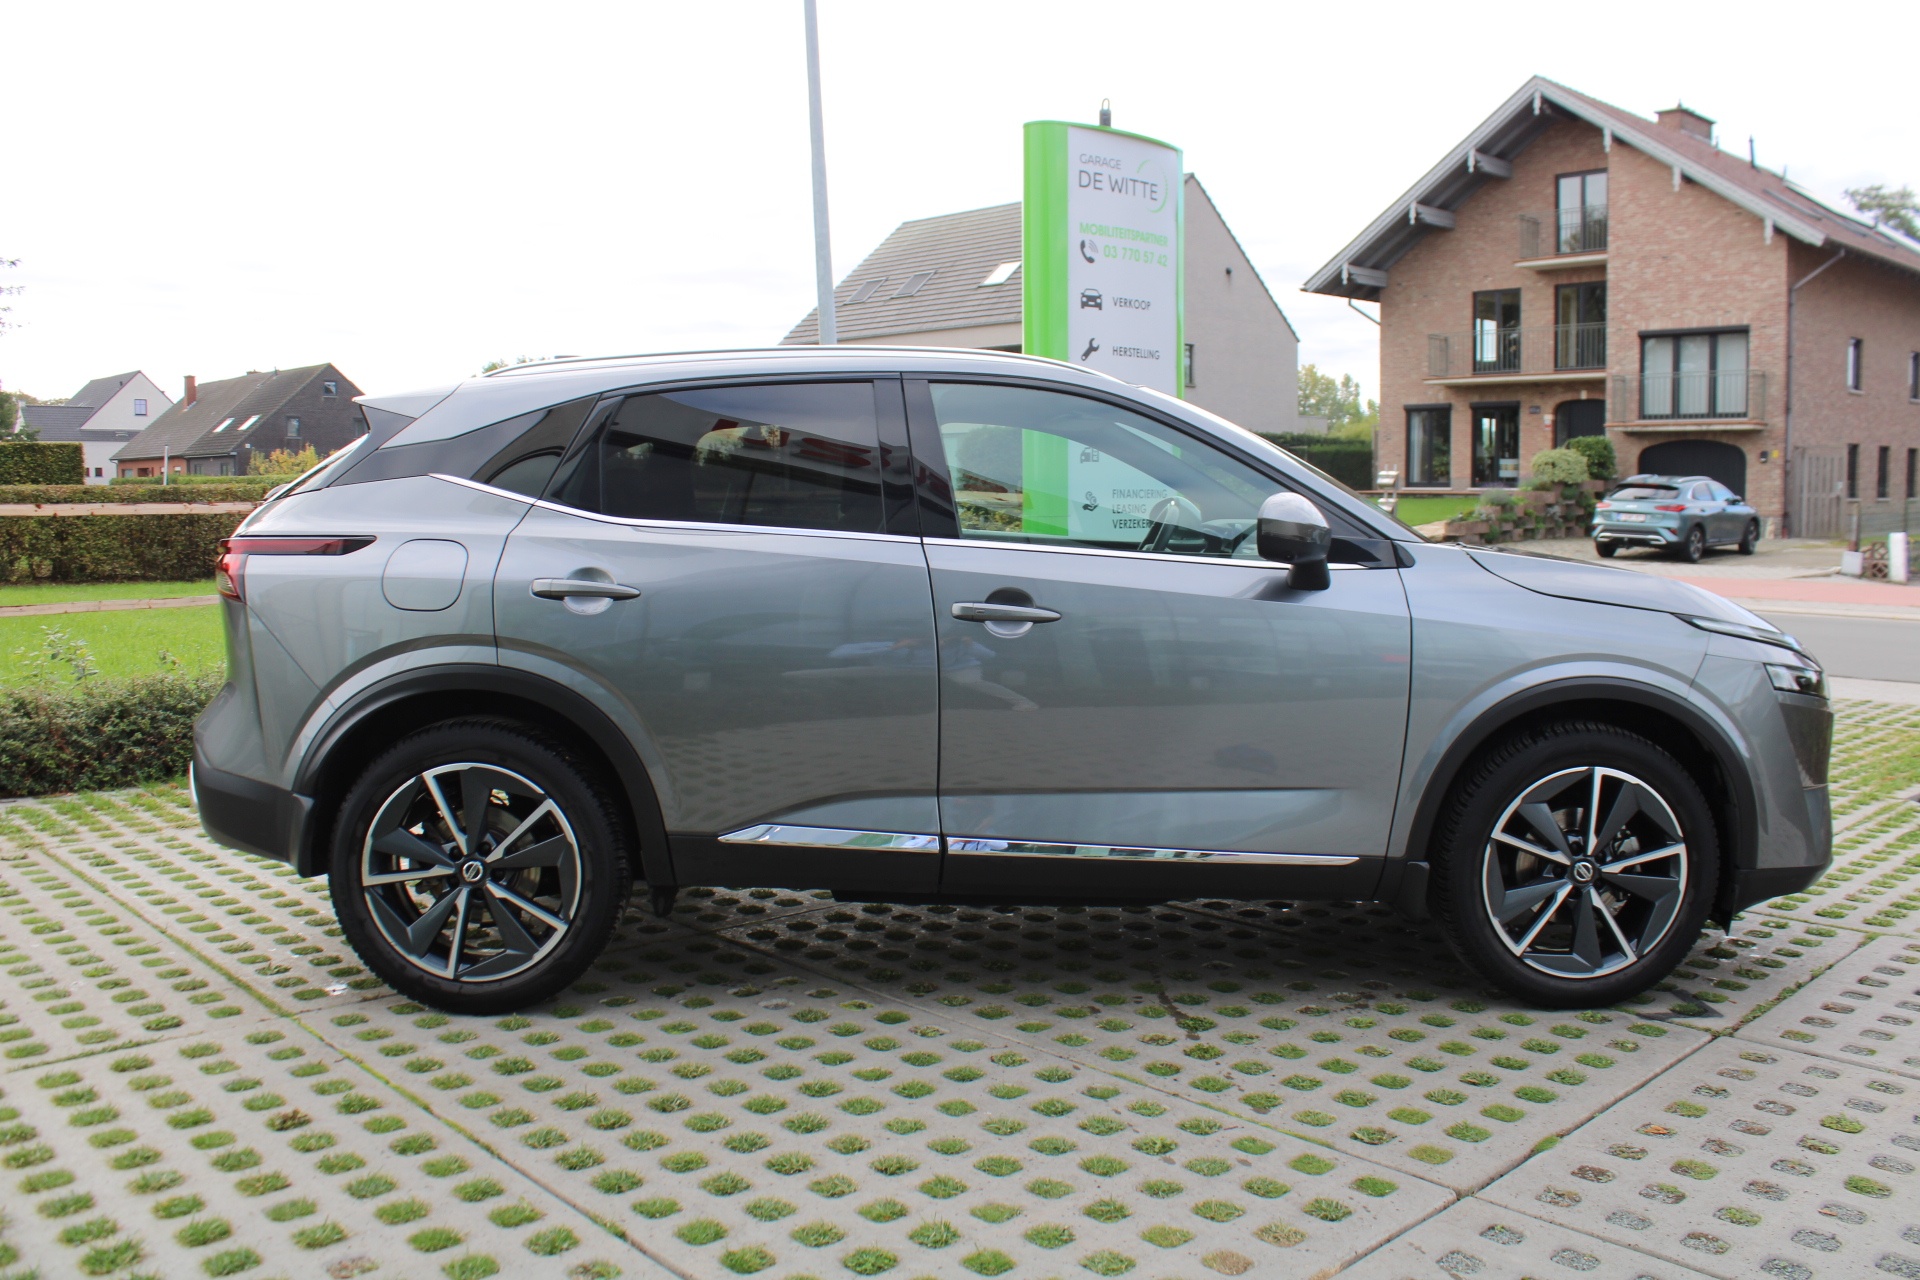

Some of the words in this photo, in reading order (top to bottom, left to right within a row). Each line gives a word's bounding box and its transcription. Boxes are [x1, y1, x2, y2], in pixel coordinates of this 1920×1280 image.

[1079, 153, 1121, 169] GARAGE
[1078, 169, 1103, 191] DE
[1108, 174, 1158, 201] WITTE
[1079, 222, 1169, 247] MOBILITEITSPARTNER
[1103, 244, 1118, 259] 03
[1121, 247, 1141, 262] 770
[1143, 251, 1155, 264] 57
[1157, 254, 1168, 267] 42
[1112, 297, 1151, 310] VERKOOP
[1112, 346, 1160, 360] HERSTELLING
[1112, 488, 1168, 499] FINANCIERING
[1112, 503, 1147, 514] LEASING
